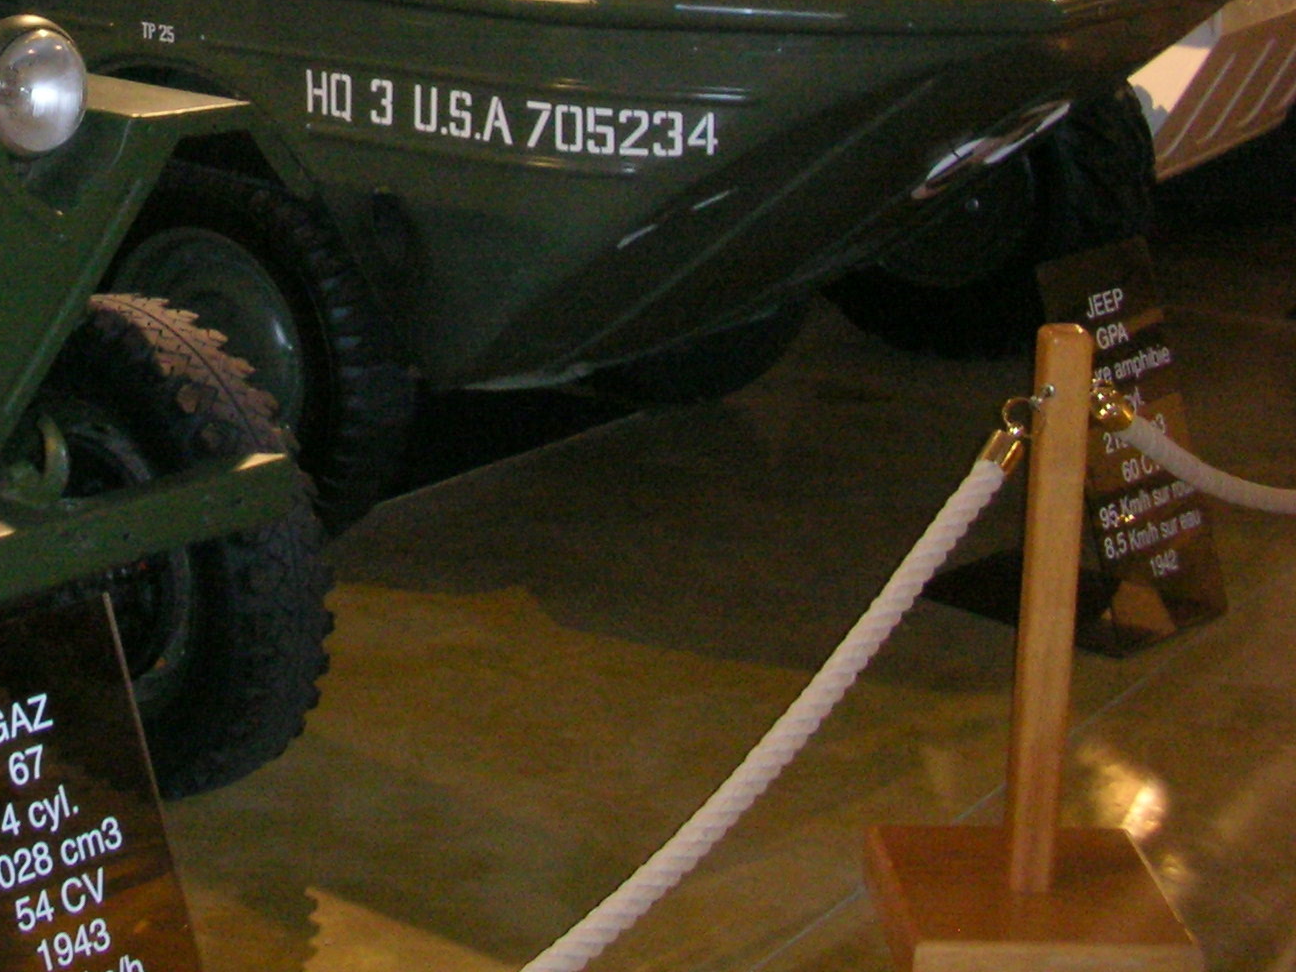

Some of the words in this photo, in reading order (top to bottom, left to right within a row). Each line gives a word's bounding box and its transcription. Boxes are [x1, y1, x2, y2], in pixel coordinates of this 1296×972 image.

[159, 24, 175, 44] 25
[306, 69, 352, 122] HQ
[370, 78, 393, 126] 3
[414, 84, 513, 145] U.S.A
[526, 100, 719, 158] 705234
[1086, 288, 1124, 318] JEEP
[1095, 322, 1129, 350] GPA
[1113, 344, 1171, 379] amphibie
[1122, 458, 1140, 483] 60
[1149, 548, 1179, 577] 1942
[8, 744, 43, 786] 67
[0, 802, 21, 836] 4
[27, 784, 79, 833] cyl.
[60, 816, 123, 866] cm3
[14, 889, 55, 932] 54
[60, 867, 104, 914] CV
[36, 918, 111, 972] 1943
